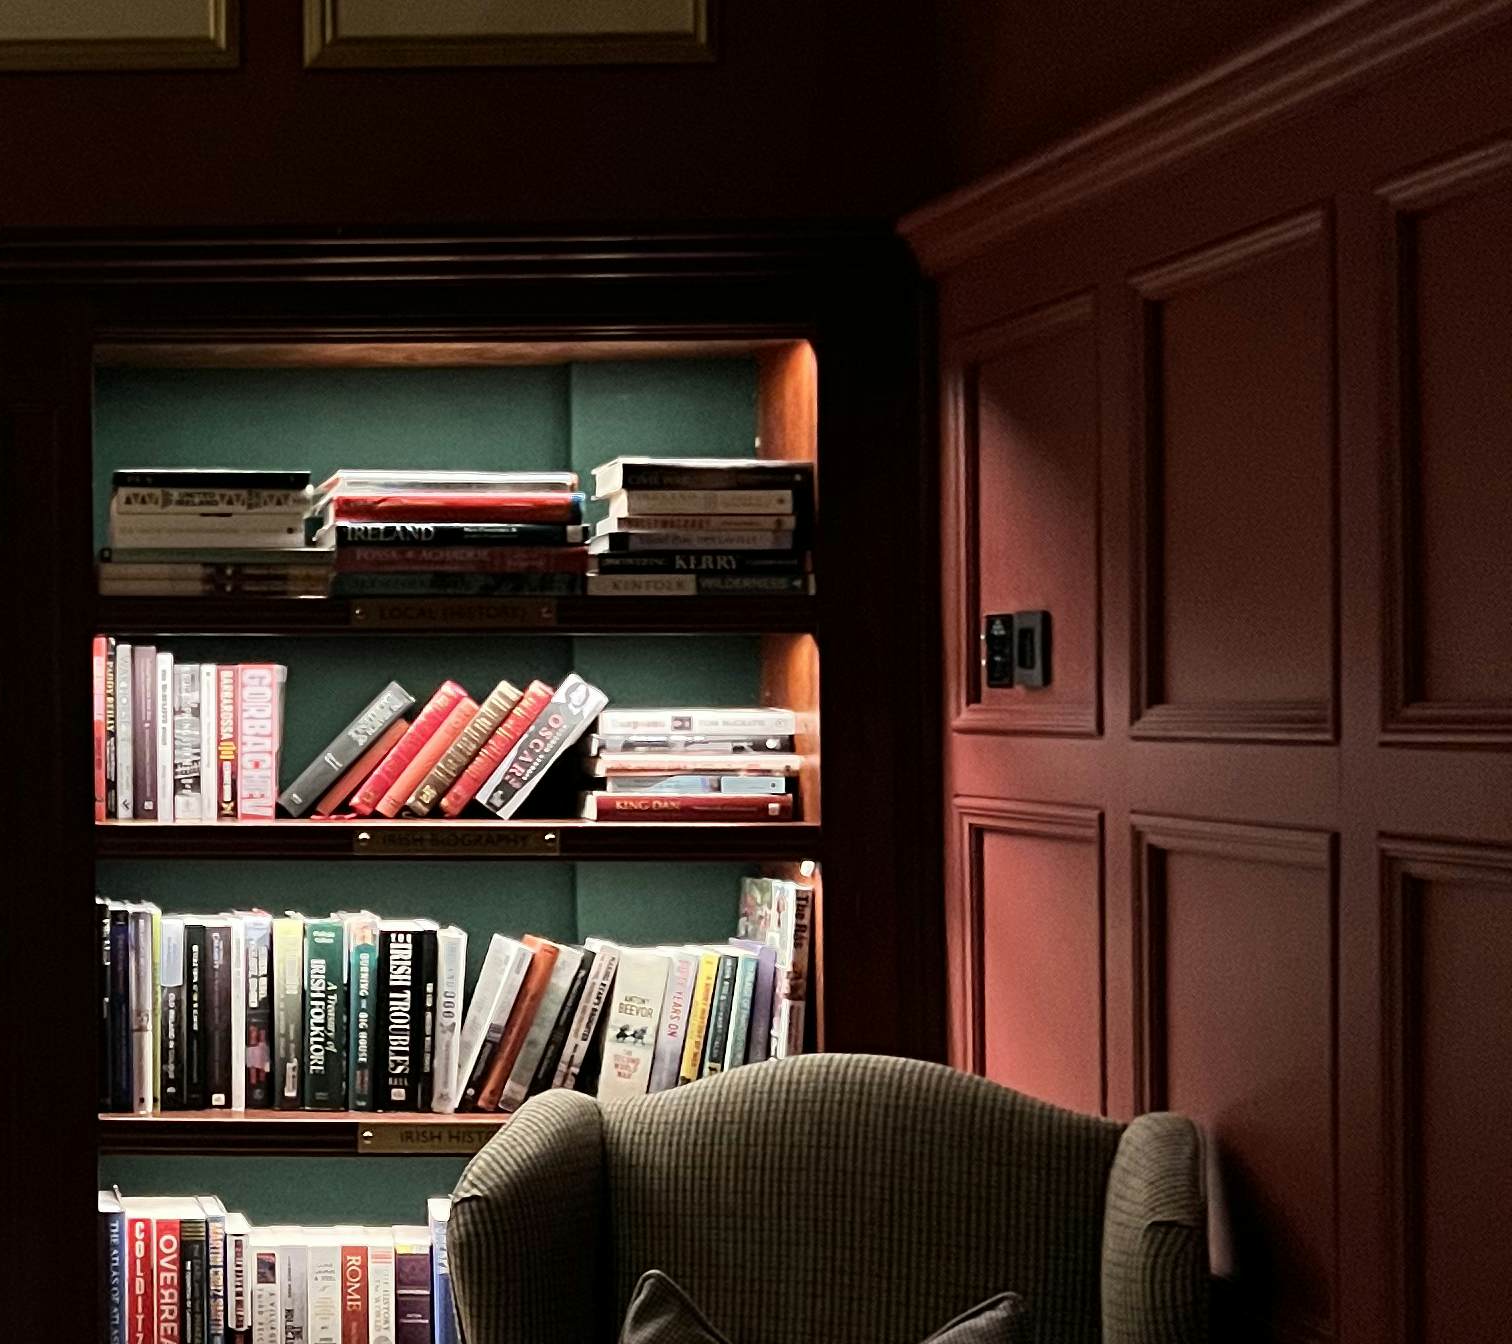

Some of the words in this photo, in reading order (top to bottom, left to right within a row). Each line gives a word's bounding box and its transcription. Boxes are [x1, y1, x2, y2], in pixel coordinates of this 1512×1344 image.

[346, 525, 434, 541] IRELAND
[675, 555, 737, 569] KERRY
[612, 578, 685, 591] KINFOLK
[221, 670, 234, 740] BARBAROSSA
[241, 669, 272, 816] GORBACHEV
[508, 713, 564, 776] OSCAR
[615, 801, 648, 811] KING
[652, 800, 680, 810] DAN
[381, 833, 423, 846] IRISH
[430, 832, 528, 846] BIOGRAPHY
[310, 959, 326, 998] IRISH
[359, 953, 370, 996] BURNING
[389, 943, 413, 986] IRISH
[327, 982, 337, 990] A
[324, 994, 337, 1040] Treasury
[359, 1012, 369, 1029] BIG
[618, 1003, 654, 1018] BEEVOR
[671, 992, 684, 1021] YEARS
[309, 1000, 325, 1075] FOLKLORE
[388, 990, 412, 1074] TROUBLES
[667, 1023, 679, 1038] ON
[326, 1041, 337, 1053] of
[358, 1031, 368, 1063] HOUSE
[400, 1131, 442, 1144] IRISH
[110, 1220, 120, 1245] THE
[110, 1249, 119, 1285] ATLAS
[110, 1287, 119, 1302] OF
[346, 1255, 362, 1311] ROME
[268, 1302, 277, 1344] VILLAGE
